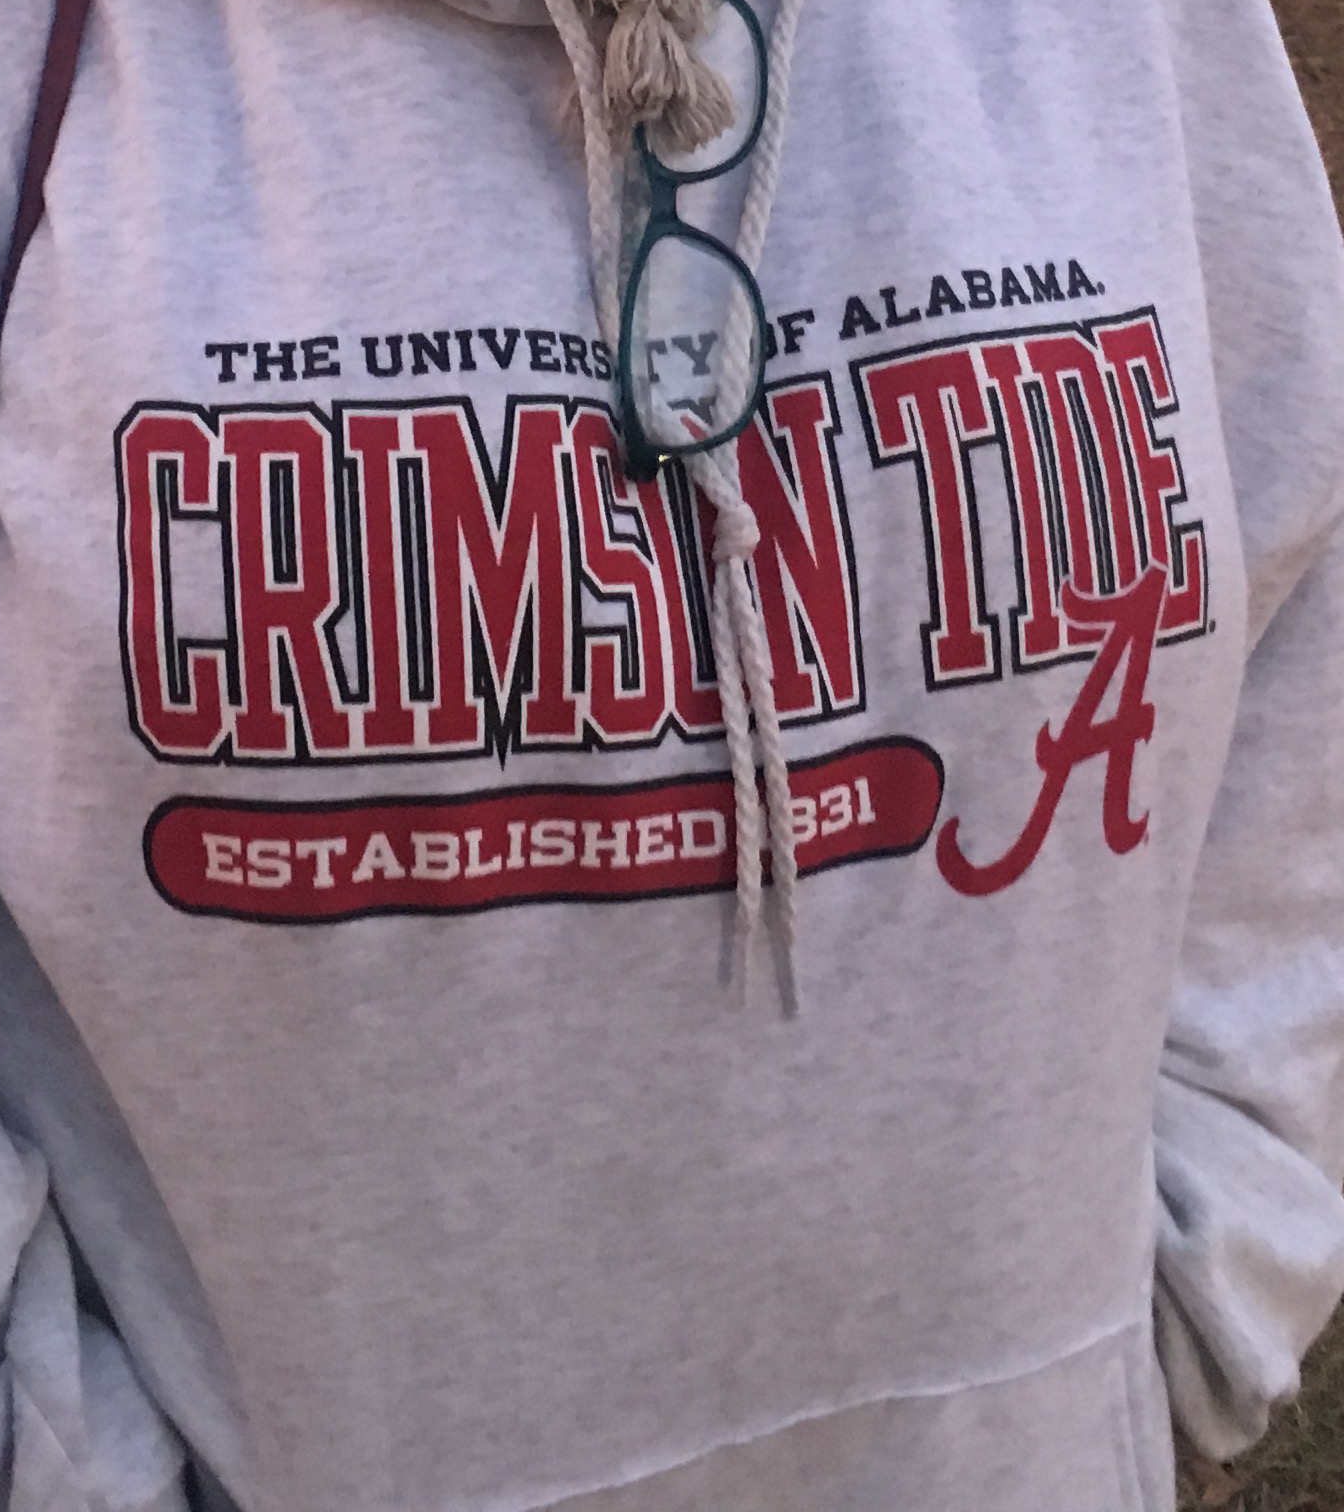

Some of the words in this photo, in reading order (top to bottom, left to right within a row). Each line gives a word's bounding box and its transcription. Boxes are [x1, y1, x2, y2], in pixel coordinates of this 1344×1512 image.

[205, 336, 341, 383] THE
[360, 328, 718, 383] UNIVERSTY
[849, 304, 1209, 692] TIDE
[202, 809, 727, 889] ESTABLISHED
[761, 777, 877, 850] 831
